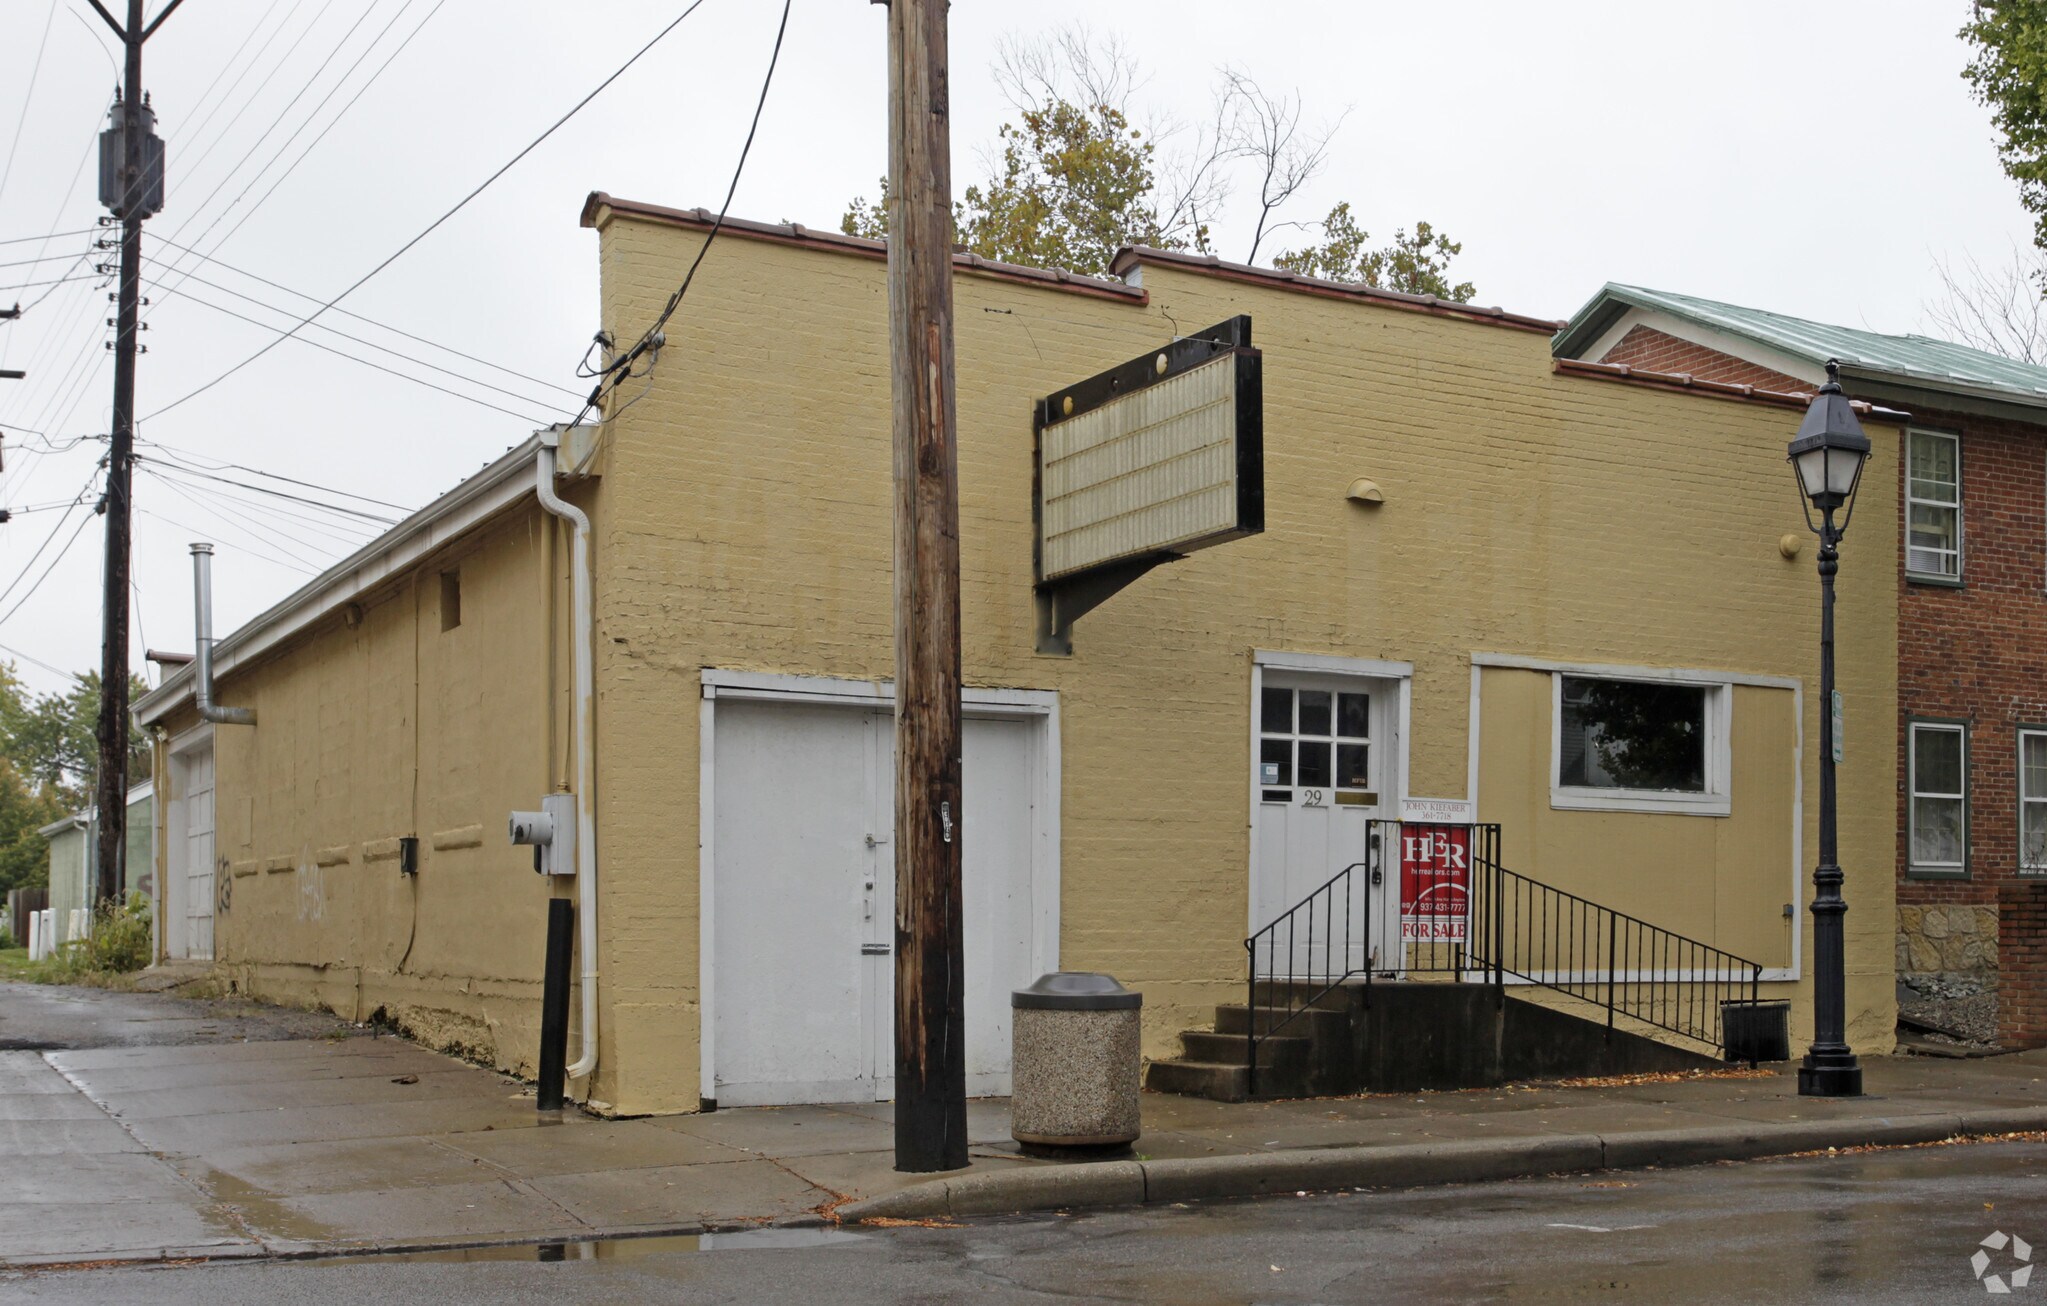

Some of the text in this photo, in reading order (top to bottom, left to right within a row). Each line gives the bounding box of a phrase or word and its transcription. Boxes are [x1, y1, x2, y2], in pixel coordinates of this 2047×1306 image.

[1304, 789, 1322, 806] 29
[1406, 801, 1466, 813] JOHN KIEFABER
[1422, 811, 1452, 820] 361-7718
[1403, 832, 1466, 868] HER
[1402, 923, 1465, 938] FOR SALE
